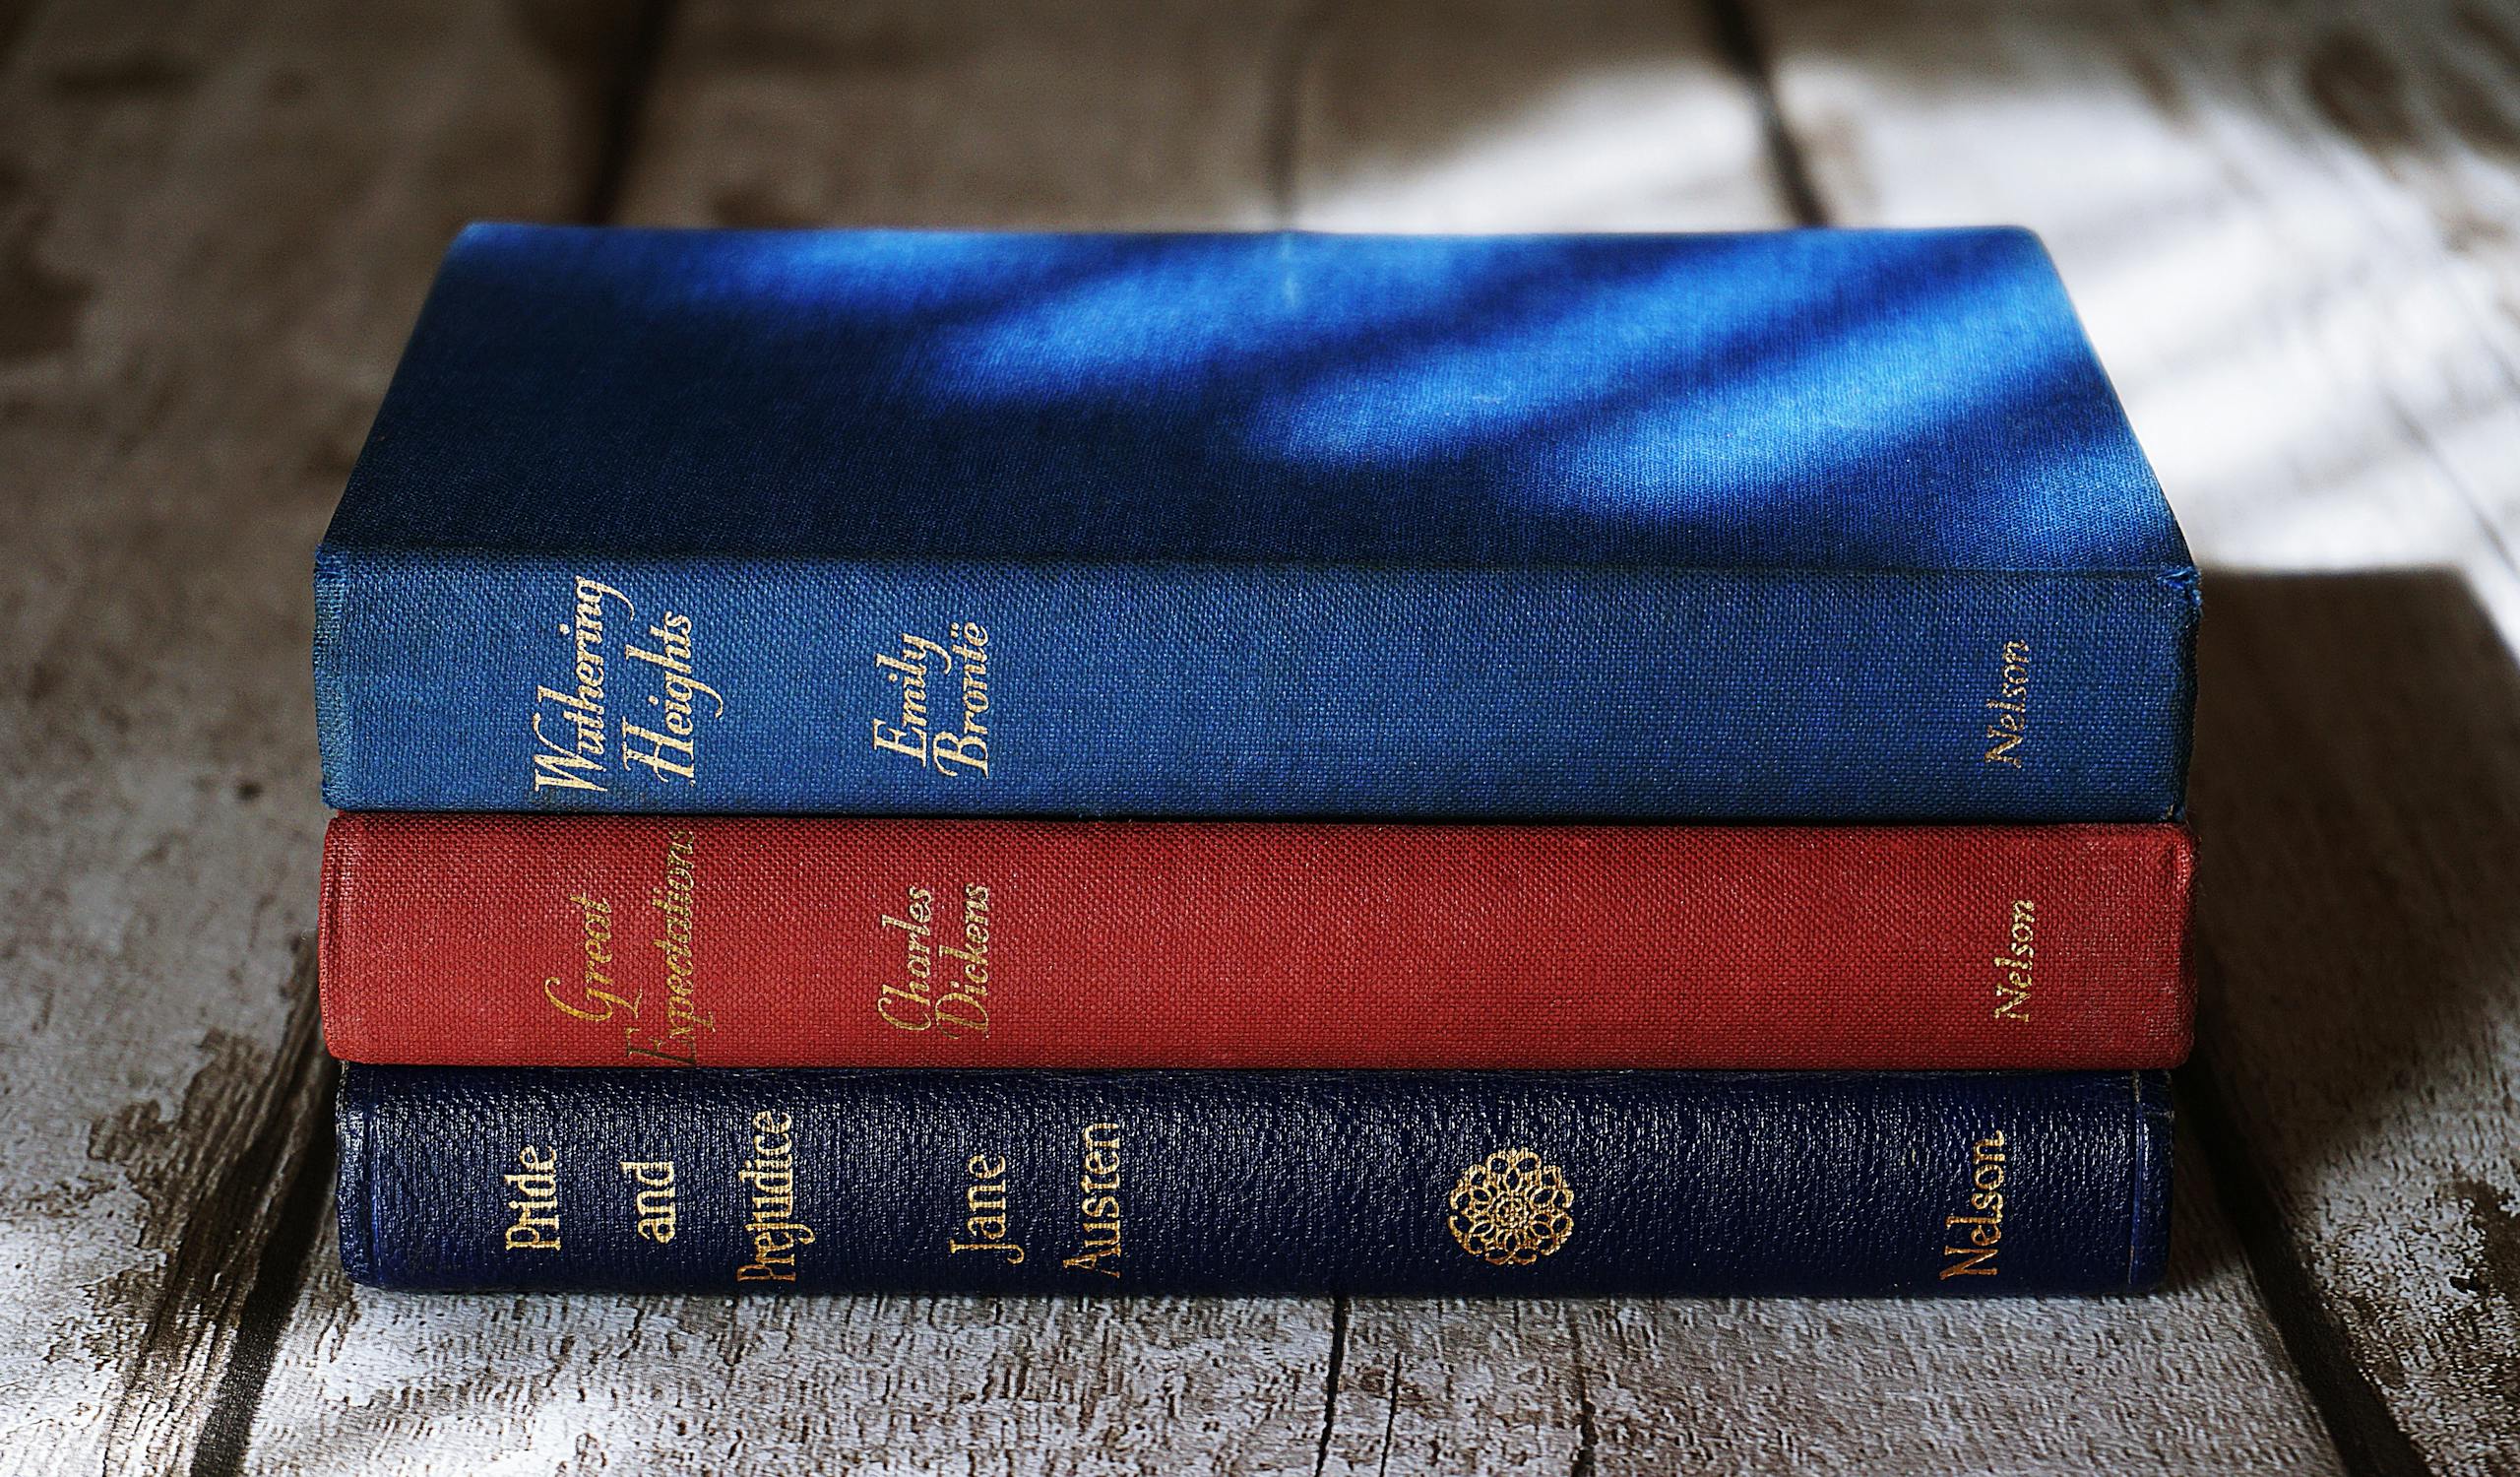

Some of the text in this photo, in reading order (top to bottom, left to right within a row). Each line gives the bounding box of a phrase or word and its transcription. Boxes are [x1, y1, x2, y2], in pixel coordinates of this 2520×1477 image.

[533, 575, 635, 792] Wuthering
[621, 610, 724, 787] Heights
[872, 632, 952, 768] Emily
[932, 621, 989, 779] Brontë
[1984, 639, 2029, 768] Nelson
[544, 892, 643, 1022] Great
[625, 830, 716, 1065] Expectations
[877, 885, 931, 1032] Charles
[935, 882, 989, 1040] Dickens
[1993, 900, 2035, 1022] Nelson
[504, 1144, 561, 1252] Pride
[620, 1160, 675, 1245] and
[736, 1111, 815, 1282] Prejudice
[950, 1154, 1025, 1264] Jane
[1063, 1123, 1121, 1278] Austen
[1939, 1129, 2005, 1280] Nelson
